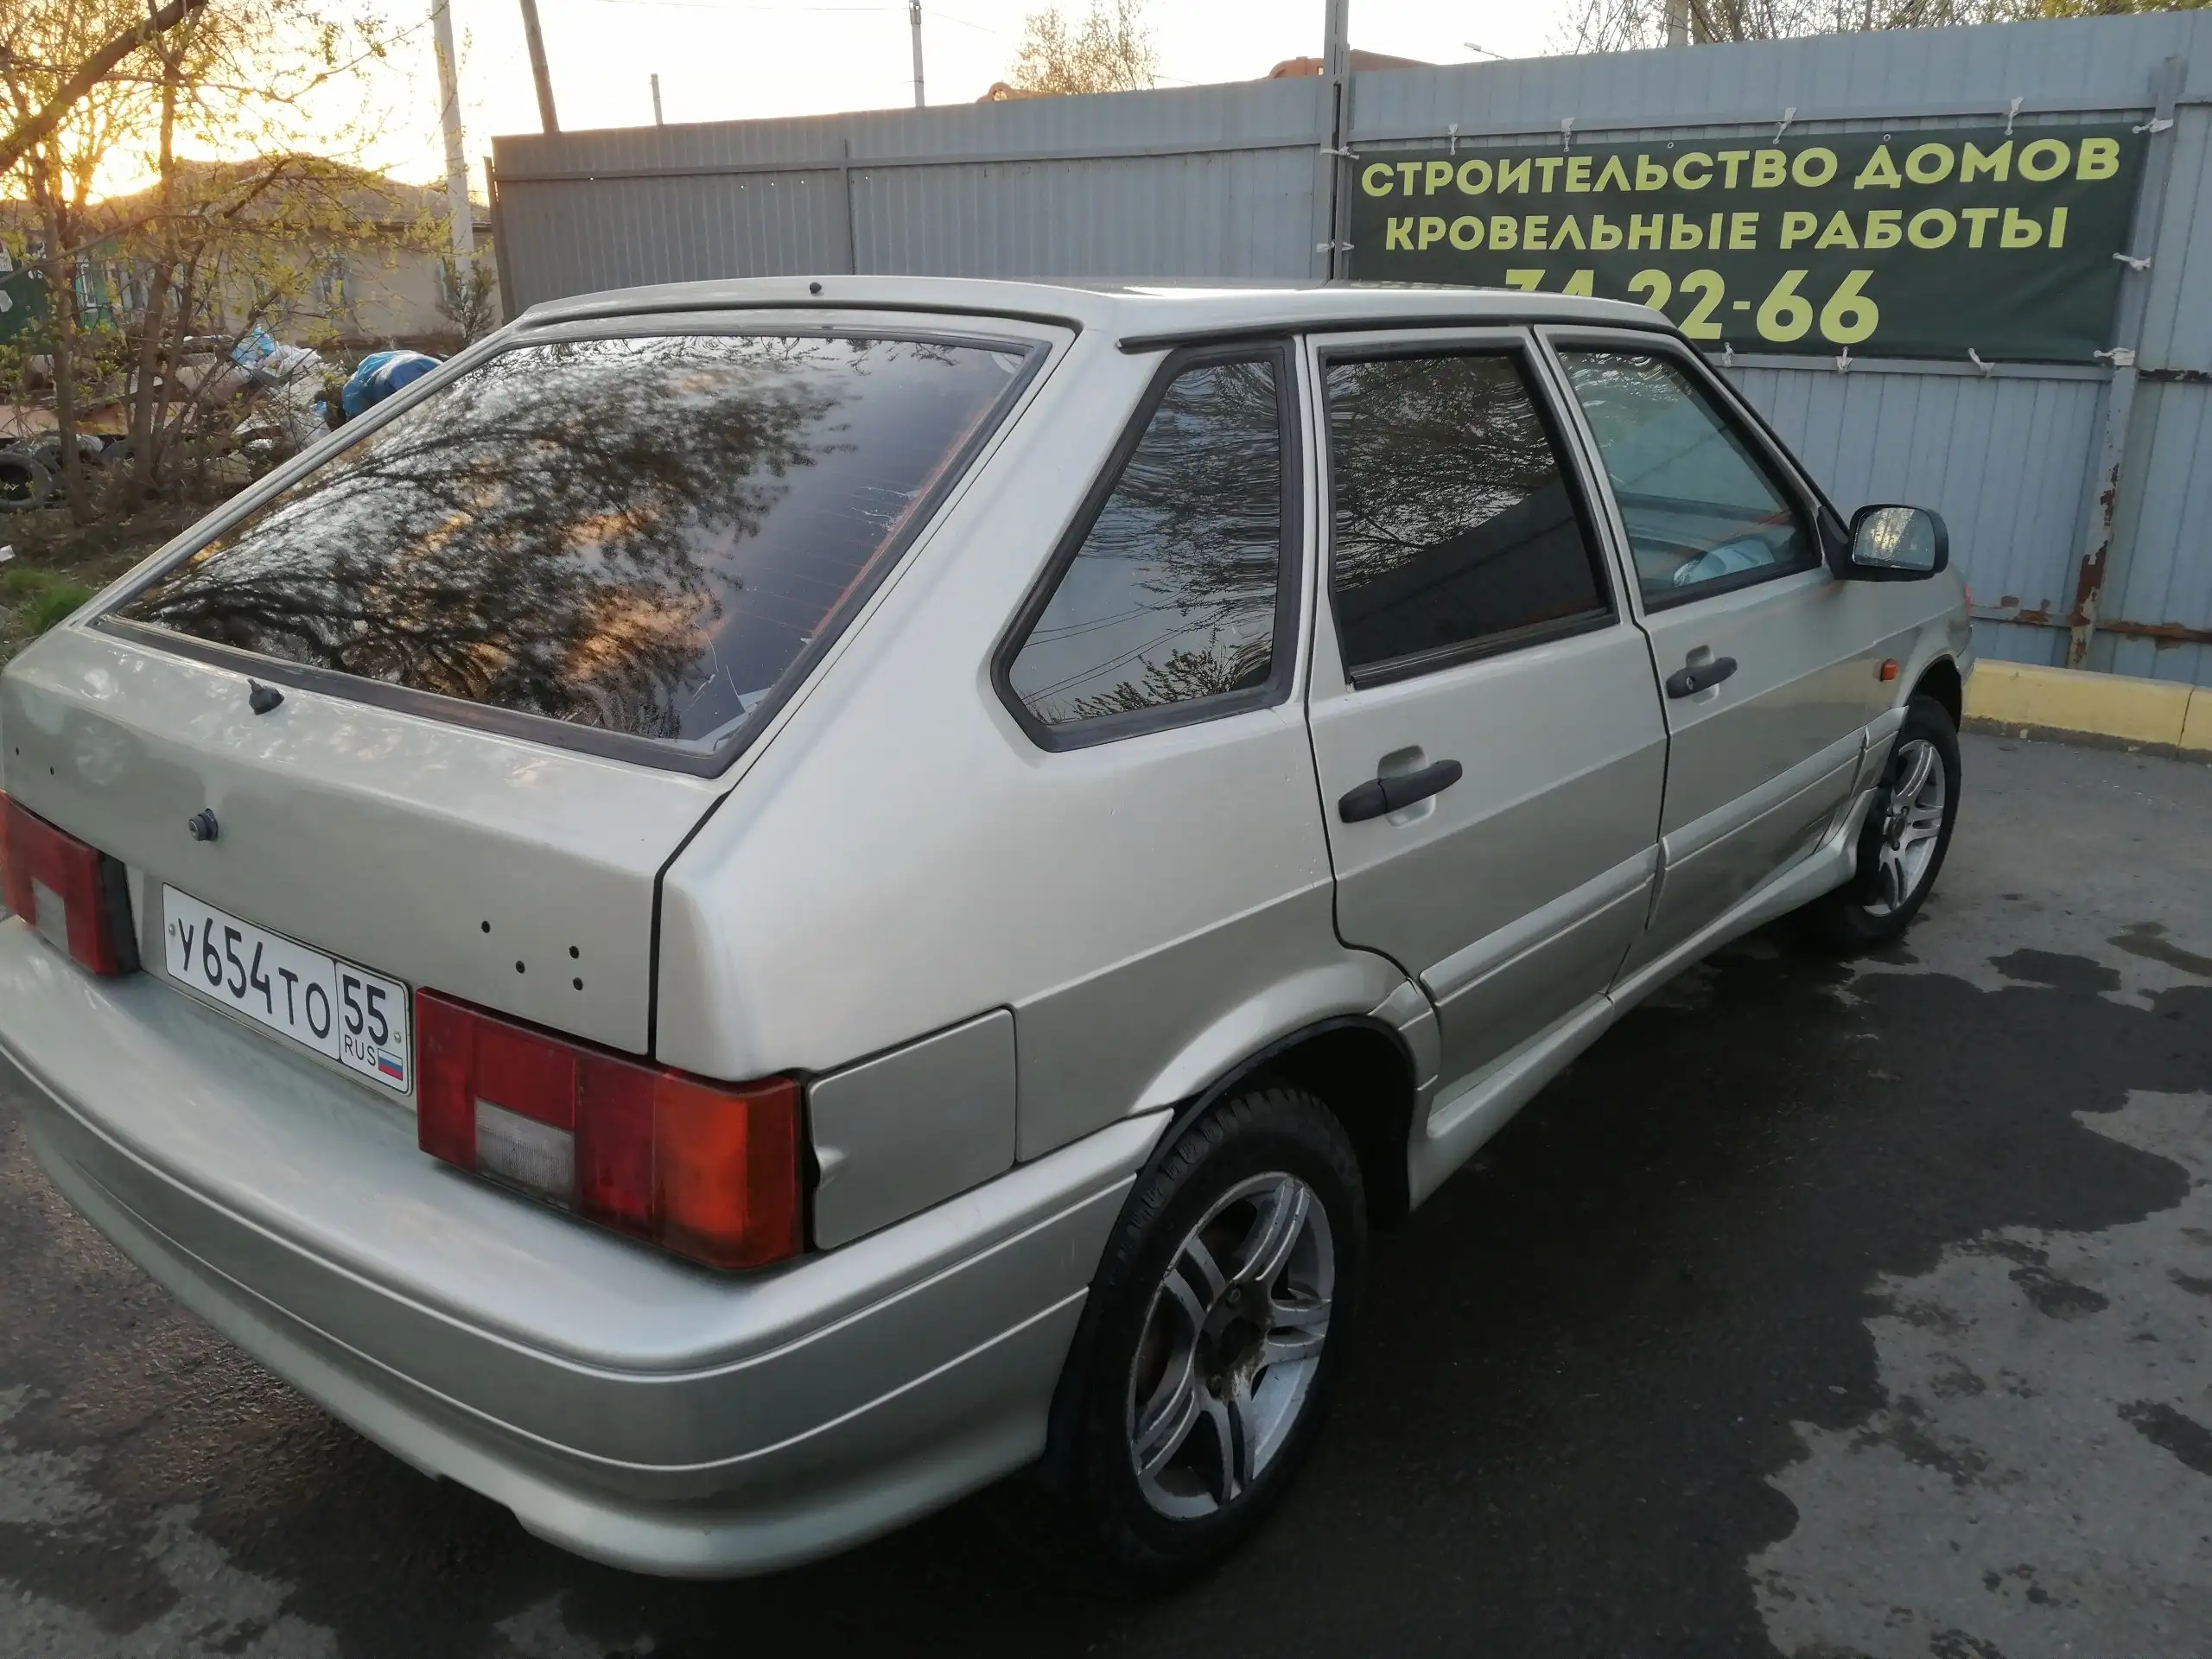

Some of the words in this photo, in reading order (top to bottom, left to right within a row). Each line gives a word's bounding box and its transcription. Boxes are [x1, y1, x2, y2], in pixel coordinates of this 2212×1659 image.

[1362, 147, 1838, 197] СТРОИТЕЛЬСТВО
[1853, 137, 2120, 189] ДОМОВ
[1386, 212, 1759, 251] КРОВЕЛЬНЫЕ
[1780, 207, 2068, 249] РАБОТЫ
[342, 974, 389, 1046] 55
[344, 1034, 377, 1066] RUS
